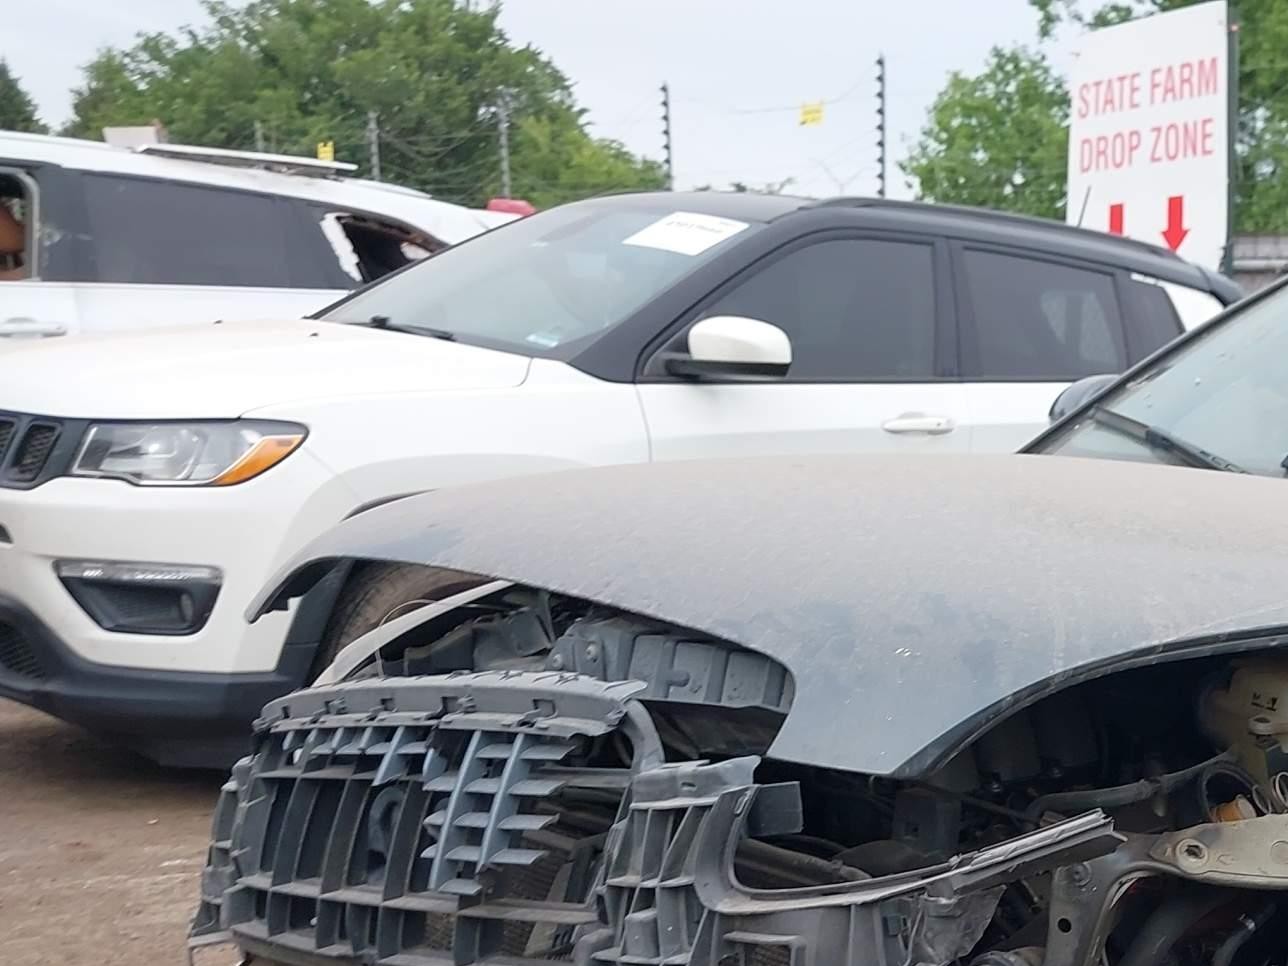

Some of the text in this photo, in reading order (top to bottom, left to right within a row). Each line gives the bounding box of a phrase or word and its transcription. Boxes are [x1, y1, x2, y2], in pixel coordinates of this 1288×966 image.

[1078, 57, 1219, 119] STATE FARM
[1080, 118, 1214, 173] DROP ZONE
